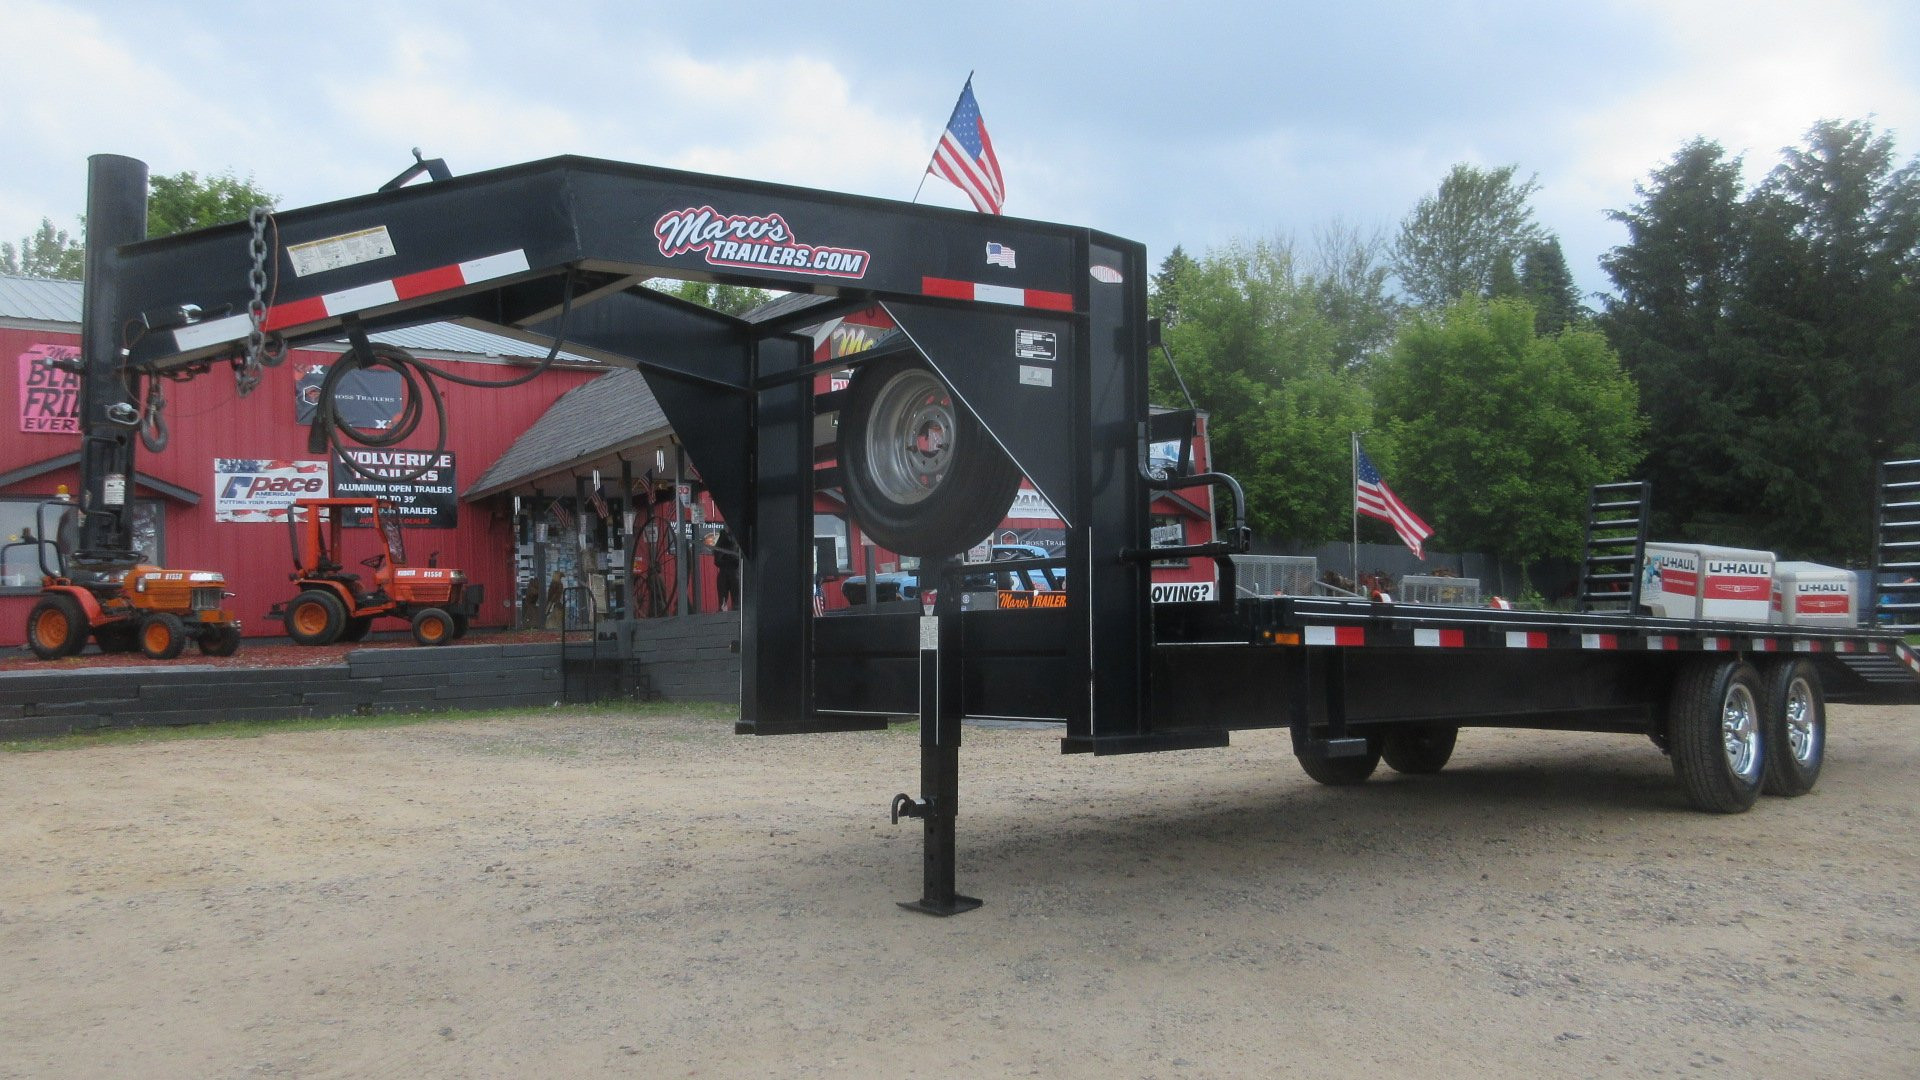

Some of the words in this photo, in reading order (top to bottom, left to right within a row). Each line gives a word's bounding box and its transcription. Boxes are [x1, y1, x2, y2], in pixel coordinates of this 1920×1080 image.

[659, 210, 788, 251] Marv's
[711, 239, 863, 272] TRAILERS.COM
[833, 326, 874, 357] Ma
[26, 359, 79, 387] BLA
[24, 417, 80, 431] EVER
[246, 476, 324, 498] pace
[337, 483, 386, 492] ALUMINUM
[389, 484, 412, 492] OPEN
[415, 485, 453, 494] TRAILERS
[354, 506, 396, 514] PONOON
[399, 506, 438, 515] TRAILERS
[1661, 556, 1696, 571] U-HAUL
[1708, 562, 1769, 576] U-HAUL
[1152, 584, 1210, 602] OVING?
[1798, 583, 1848, 592] U-HAUL
[1031, 594, 1067, 608] TRAILER
